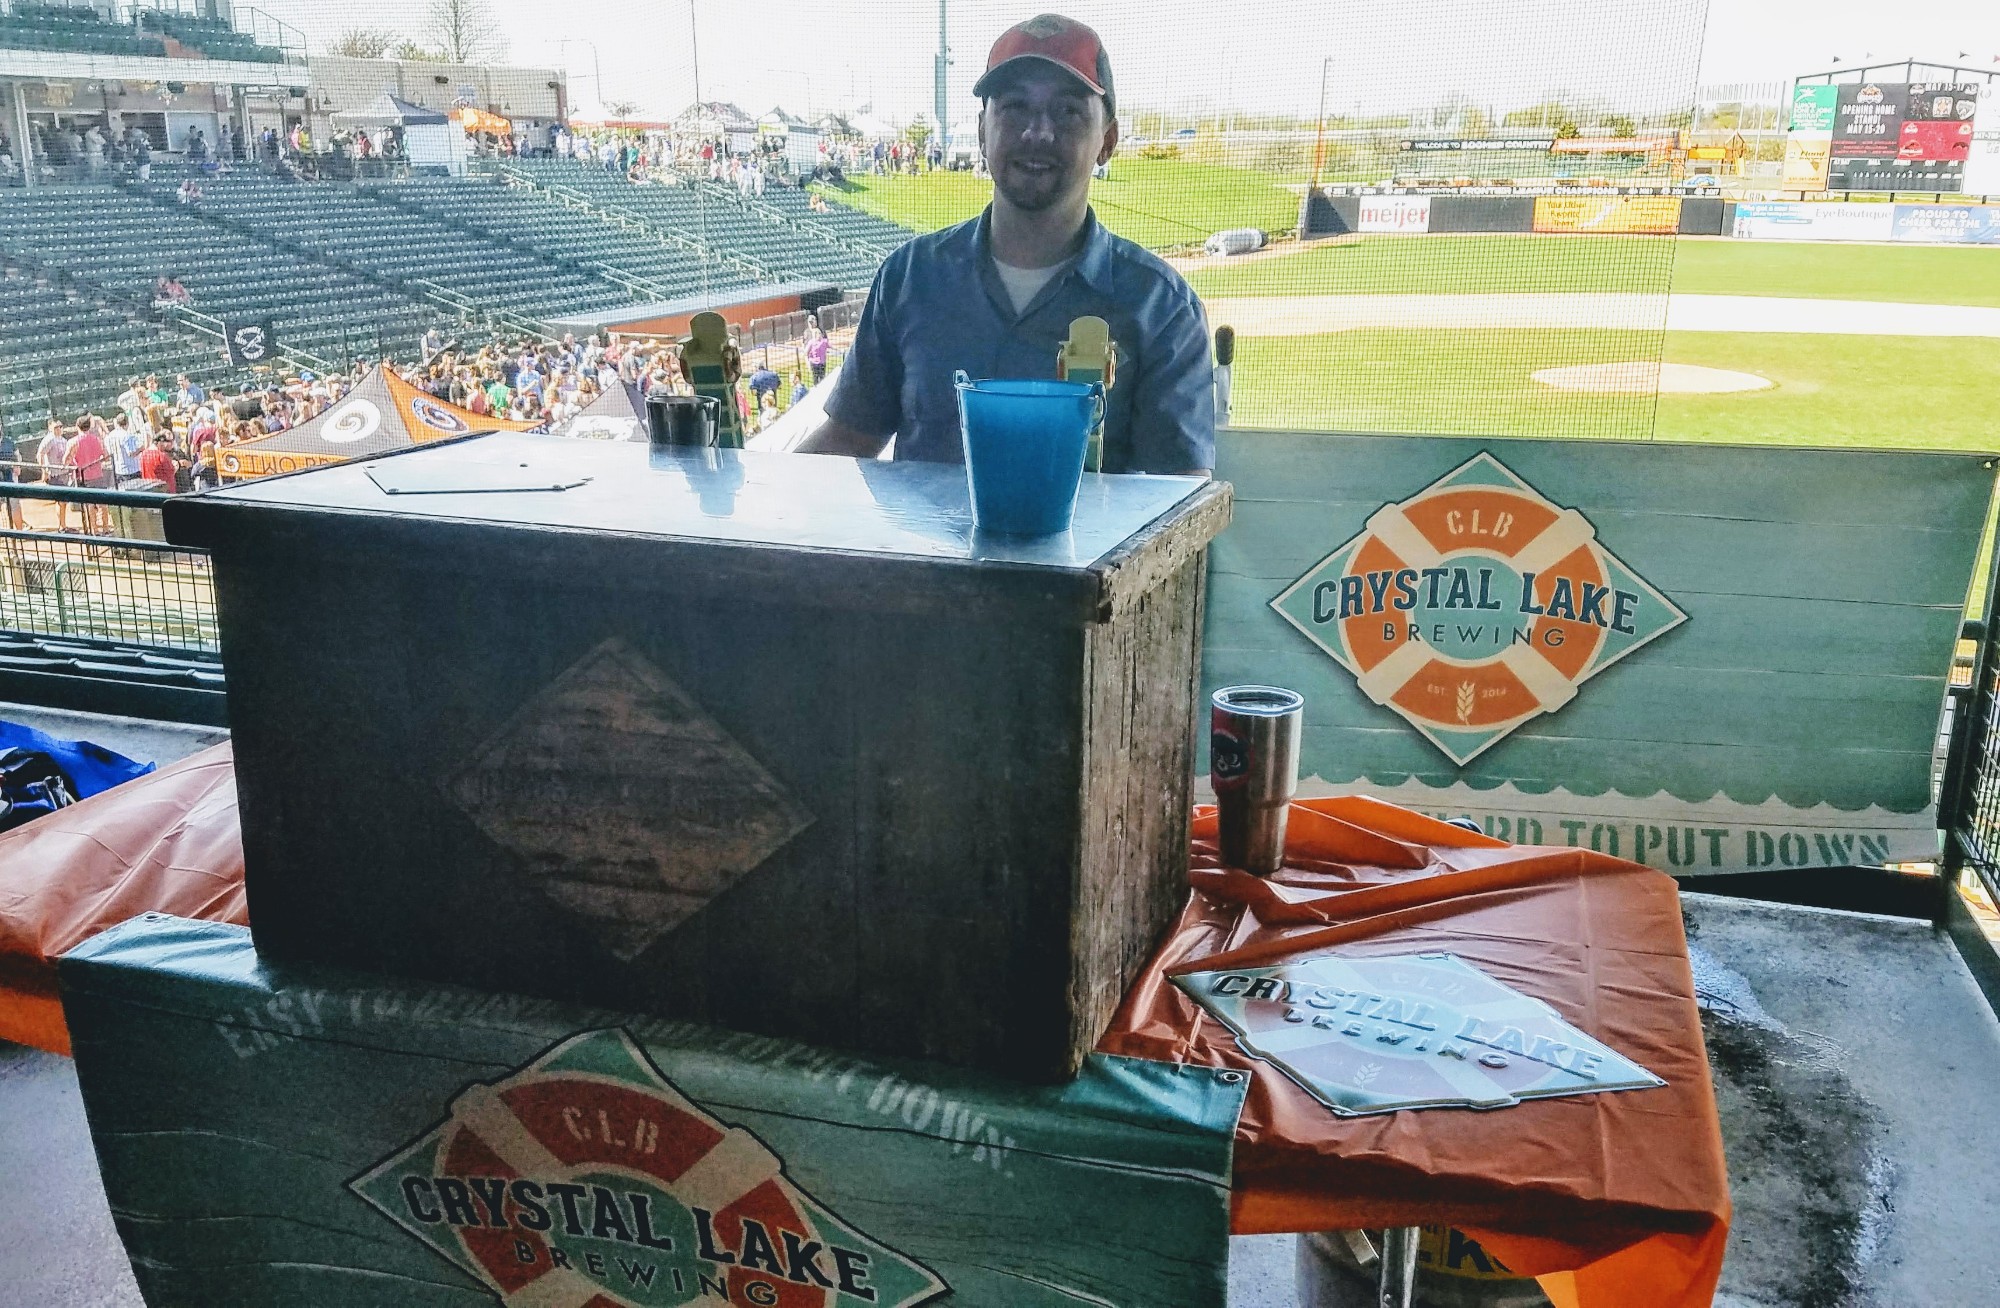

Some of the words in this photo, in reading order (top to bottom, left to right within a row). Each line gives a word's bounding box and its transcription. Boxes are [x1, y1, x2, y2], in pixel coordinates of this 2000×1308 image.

[1842, 104, 1874, 115] OPENING
[1875, 104, 1896, 115] HOME
[1846, 123, 1863, 134] MAY
[1361, 202, 1429, 228] meijer
[1899, 218, 1932, 227] CHEER
[1935, 219, 1956, 228] FOR
[1959, 219, 1980, 229] THE
[1912, 209, 1950, 219] PROUD
[1953, 210, 1968, 219] TO
[245, 454, 297, 475] TWO
[1446, 508, 1514, 539] CLB
[1312, 567, 1502, 625] CRYSTAL
[1519, 571, 1640, 636] LAKE
[1383, 622, 1566, 648] BREWING
[1560, 820, 1619, 858] TO
[1635, 824, 1729, 868] PUT
[1746, 829, 1890, 868] DOWN
[1211, 973, 1438, 1032] CRYSTAL
[1454, 1015, 1606, 1079] LAKE
[1283, 1006, 1511, 1069] BREWING
[560, 1105, 660, 1155] CLB
[401, 1174, 674, 1251] CRYSTAL
[691, 1206, 879, 1301] LAKE
[514, 1239, 778, 1306] BREWING
